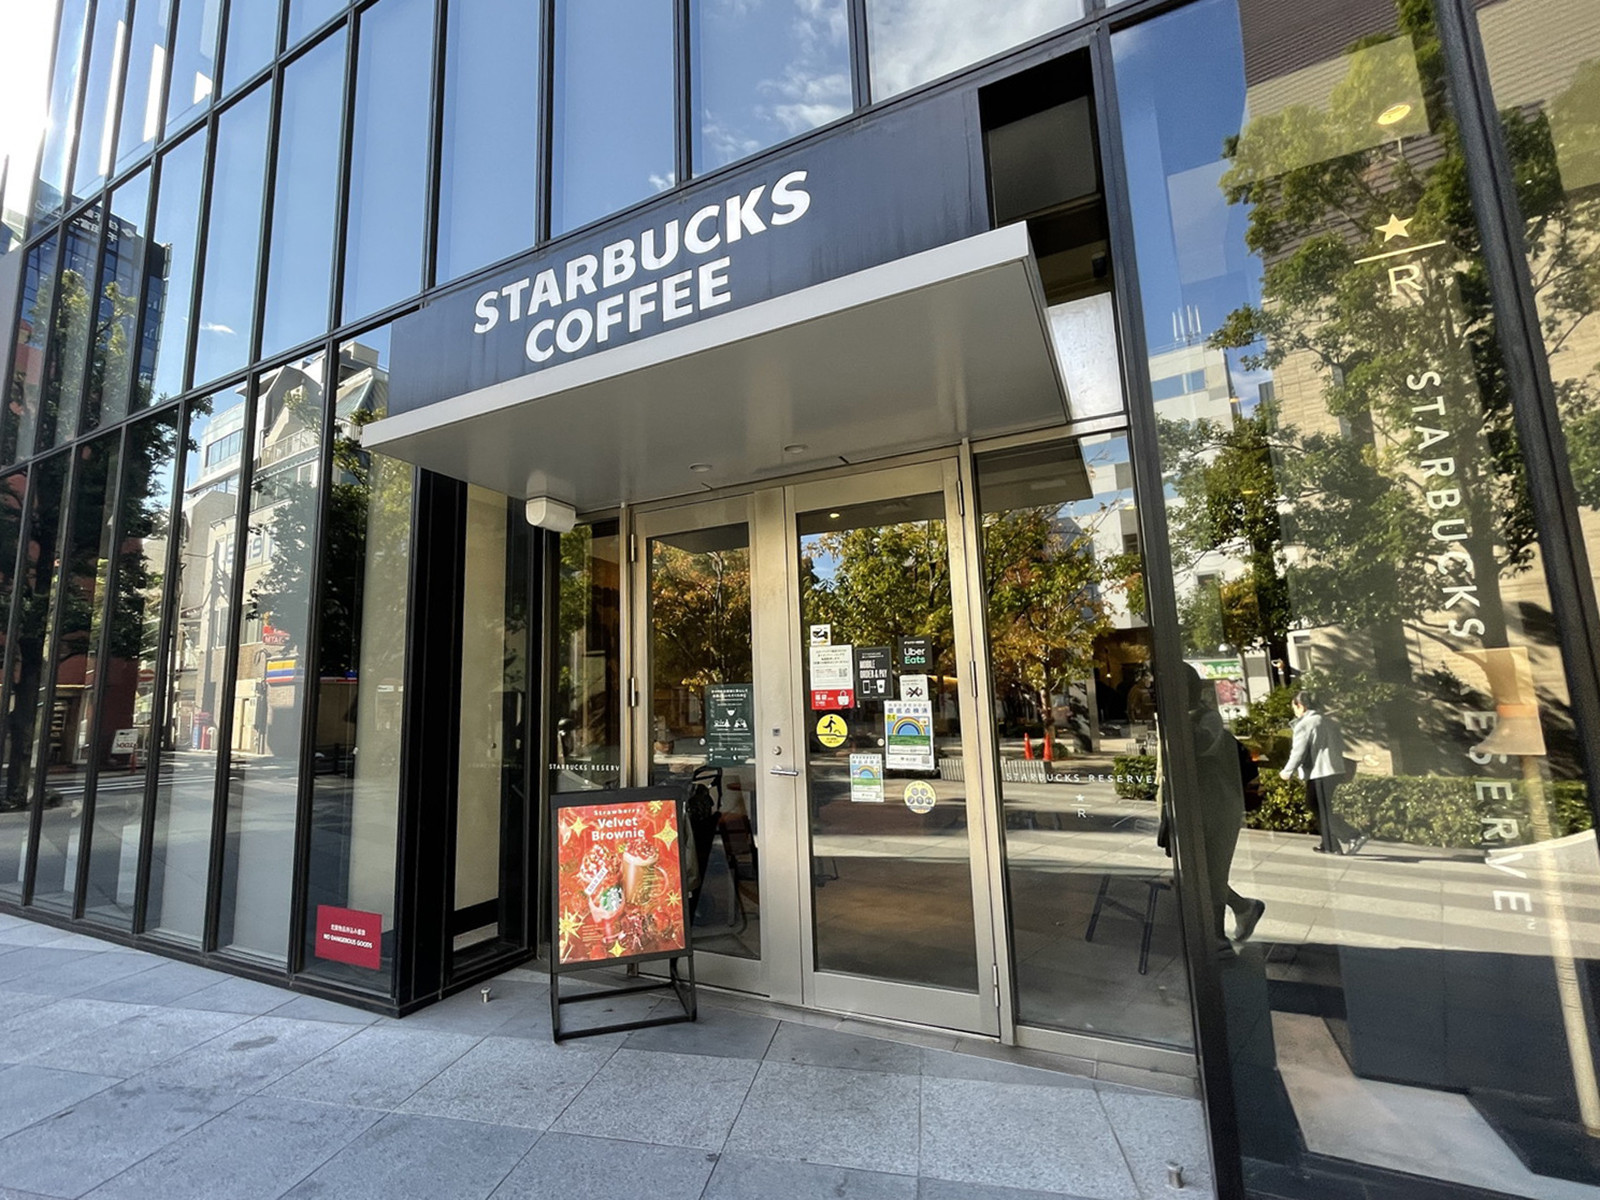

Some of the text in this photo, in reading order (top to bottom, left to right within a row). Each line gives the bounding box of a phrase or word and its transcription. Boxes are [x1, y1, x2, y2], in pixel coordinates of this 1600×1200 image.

[473, 170, 811, 334] STARBUCKS
[1388, 264, 1423, 296] R
[525, 256, 731, 363] COFFEE
[1406, 371, 1485, 637] STARBUCKS
[904, 647, 926, 656] Uber
[904, 656, 926, 665] Eats
[549, 763, 588, 771] STARBUCKS
[1006, 773, 1153, 784] STARBUCKS RESERVE
[594, 808, 640, 816] Strawberry
[1077, 808, 1087, 818] R
[1463, 709, 1532, 912] ESERVE
[598, 817, 638, 829] Velvet
[592, 828, 645, 841] Brownie
[356, 939, 373, 949] GOODS
